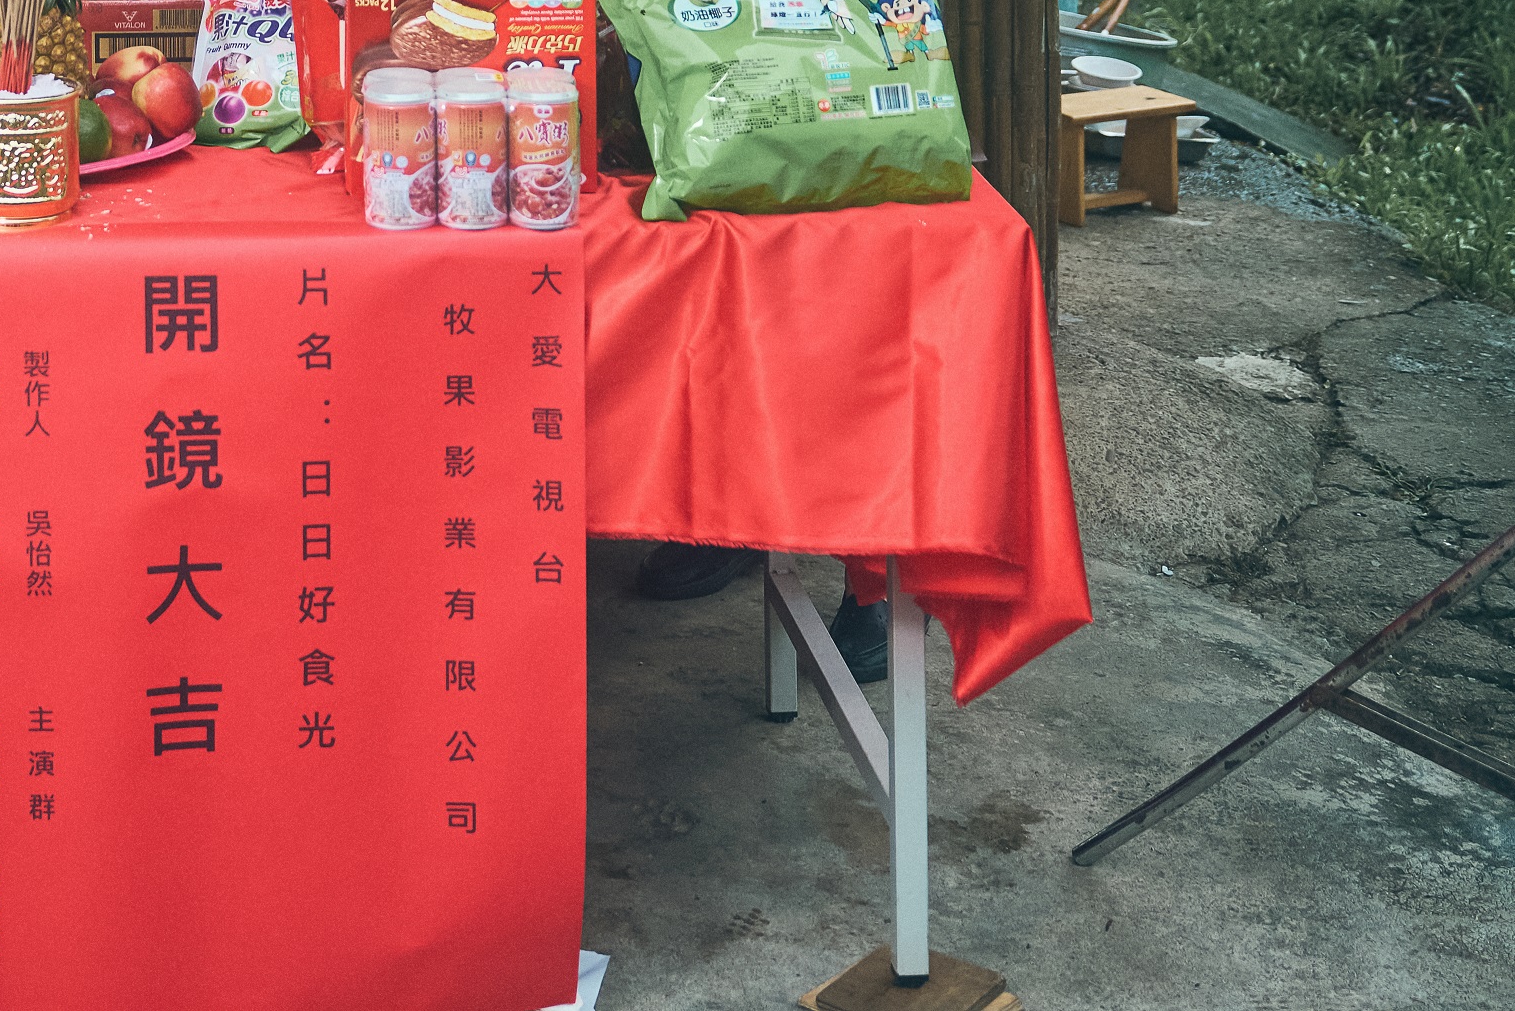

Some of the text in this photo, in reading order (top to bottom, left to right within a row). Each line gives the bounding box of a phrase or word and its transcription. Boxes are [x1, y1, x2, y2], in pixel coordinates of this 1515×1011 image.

[114, 21, 146, 29] VITALON
[205, 41, 252, 55] Fruit Gummy
[505, 34, 584, 56] 巧克力派
[680, 5, 736, 23] 奶油椰子
[518, 119, 570, 148] 八寶粥
[531, 263, 564, 584] 大愛電視台
[23, 351, 53, 596] 製作人 吳怡然
[143, 274, 223, 757] 開鏡大吉
[443, 303, 477, 834] 牧果影業有限公司
[29, 706, 55, 820] 主演群
